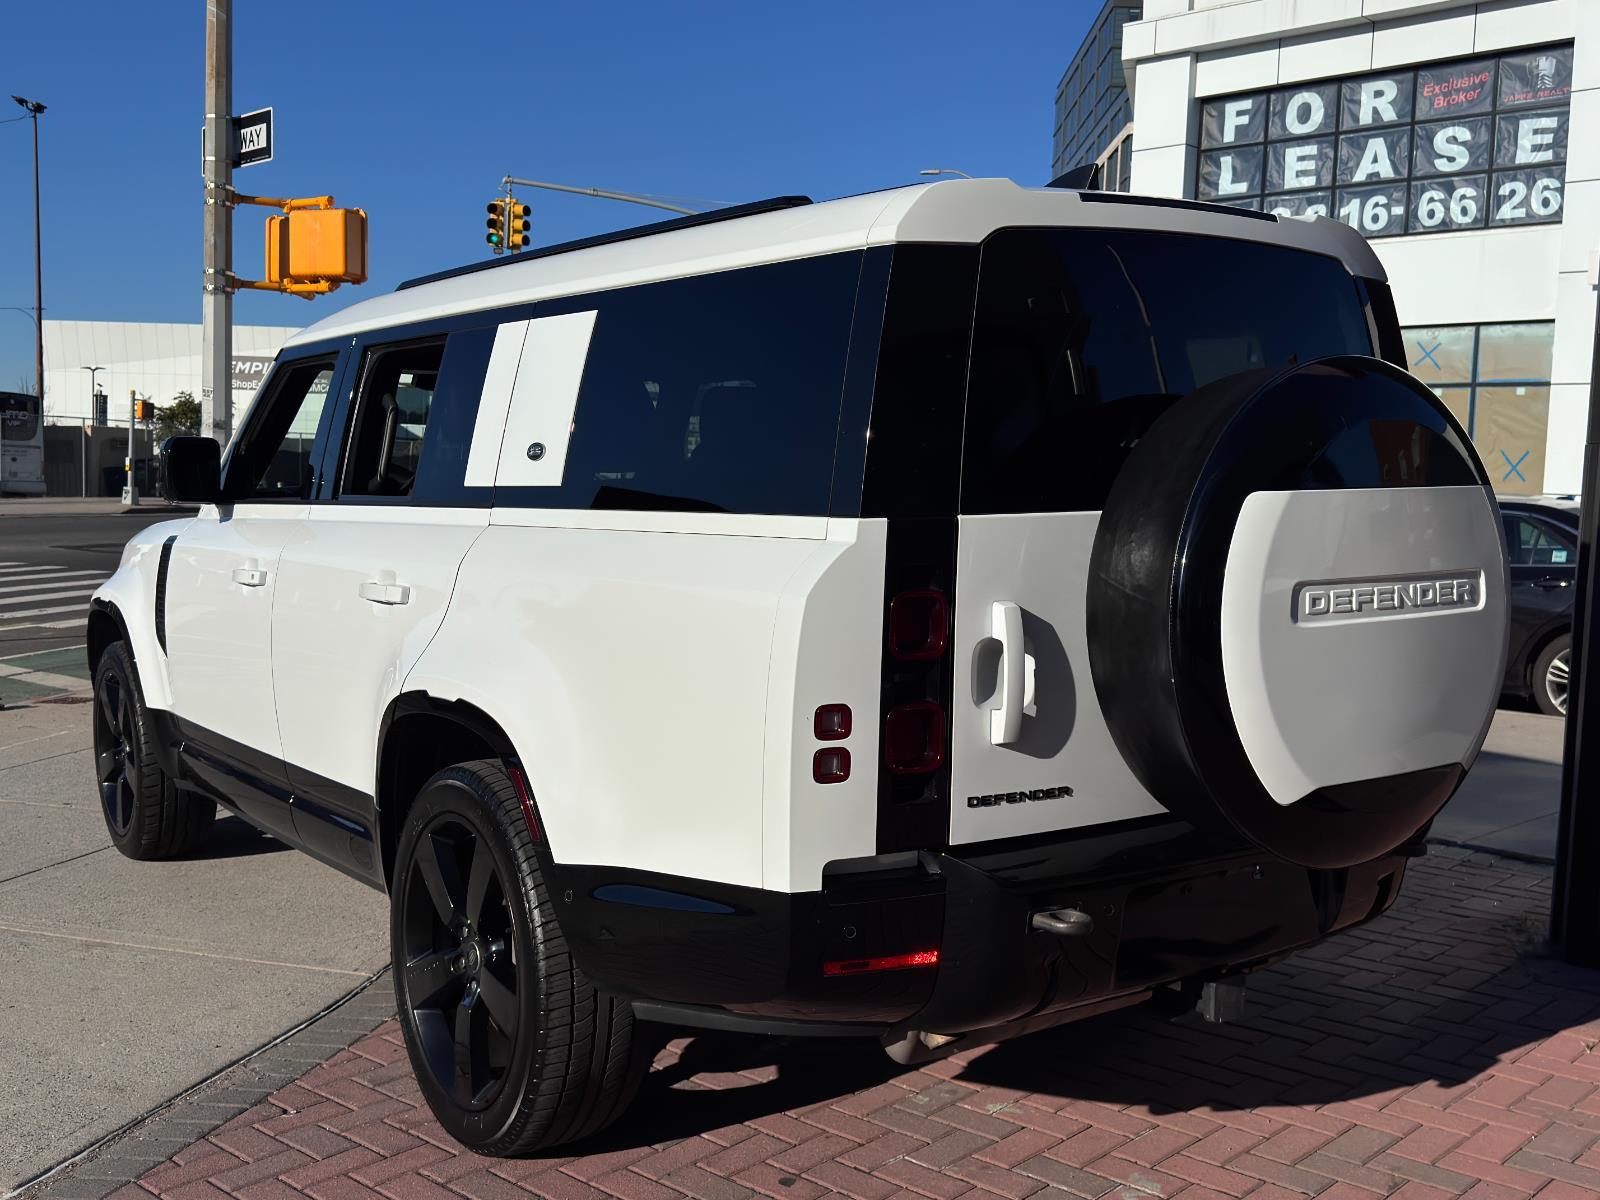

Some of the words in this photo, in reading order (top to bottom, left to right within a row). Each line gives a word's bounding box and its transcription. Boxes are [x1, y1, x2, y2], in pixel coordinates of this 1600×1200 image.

[1423, 71, 1489, 97] Exclusive
[1433, 88, 1481, 109] Broker
[1222, 79, 1399, 144] FOR
[1217, 116, 1559, 196] LEASE
[1305, 578, 1473, 616] DEFENDER
[967, 785, 1074, 809] DEFENDER
